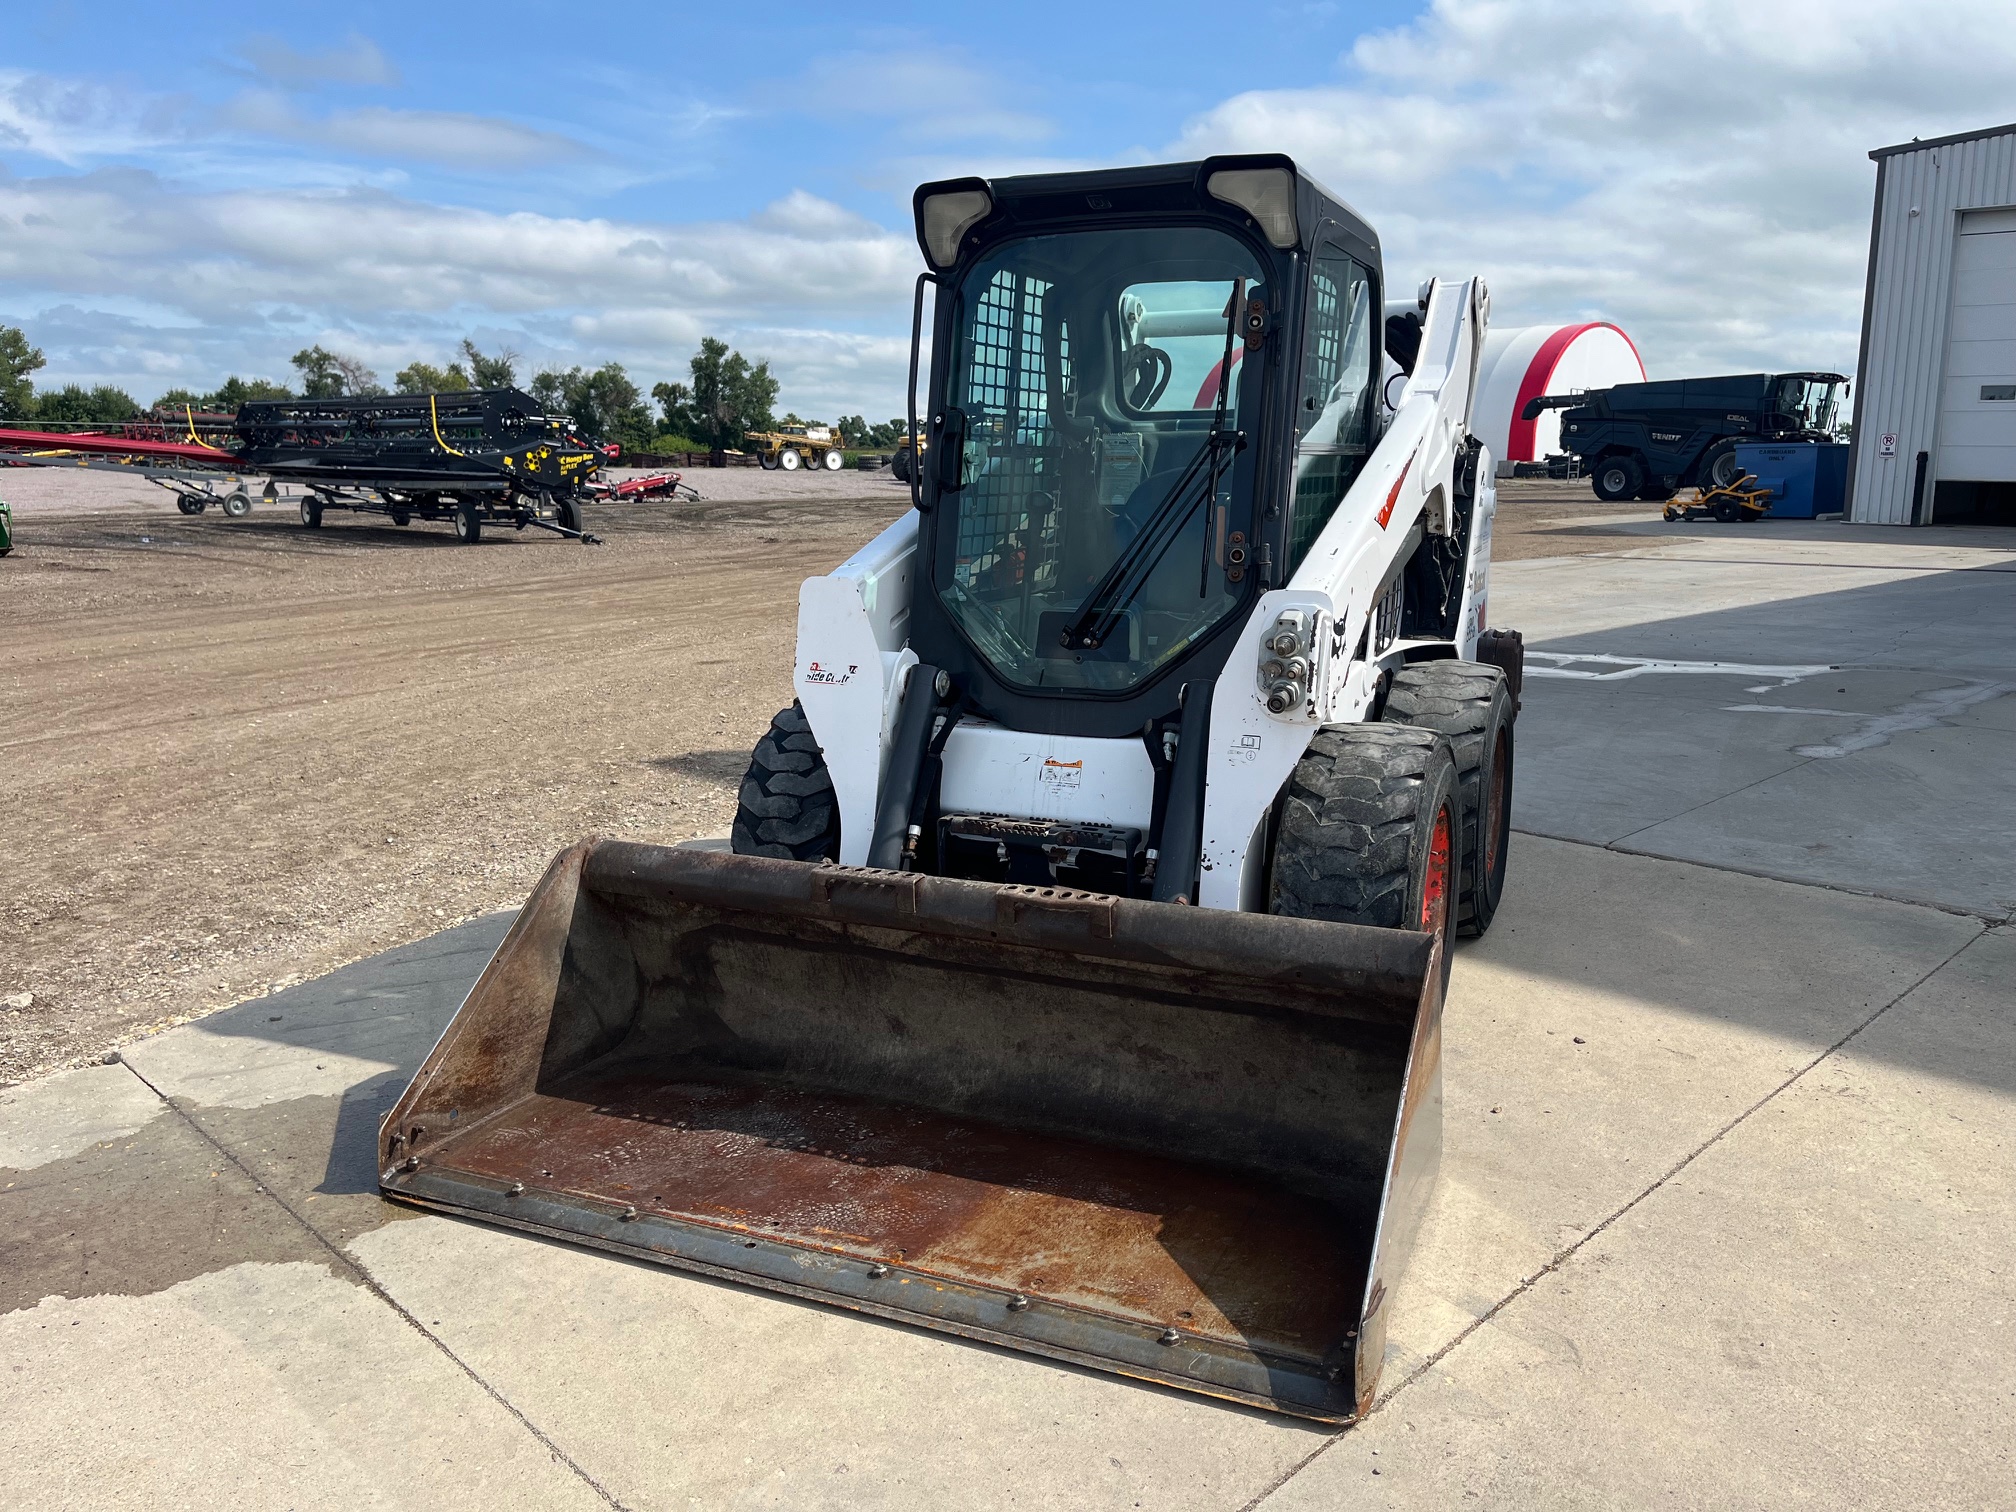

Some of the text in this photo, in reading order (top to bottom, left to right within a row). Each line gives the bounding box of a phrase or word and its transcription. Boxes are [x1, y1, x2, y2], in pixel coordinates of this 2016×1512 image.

[1727, 414, 1750, 422] IDEAL
[1652, 432, 1681, 441] FENDT
[566, 456, 582, 464] Honey
